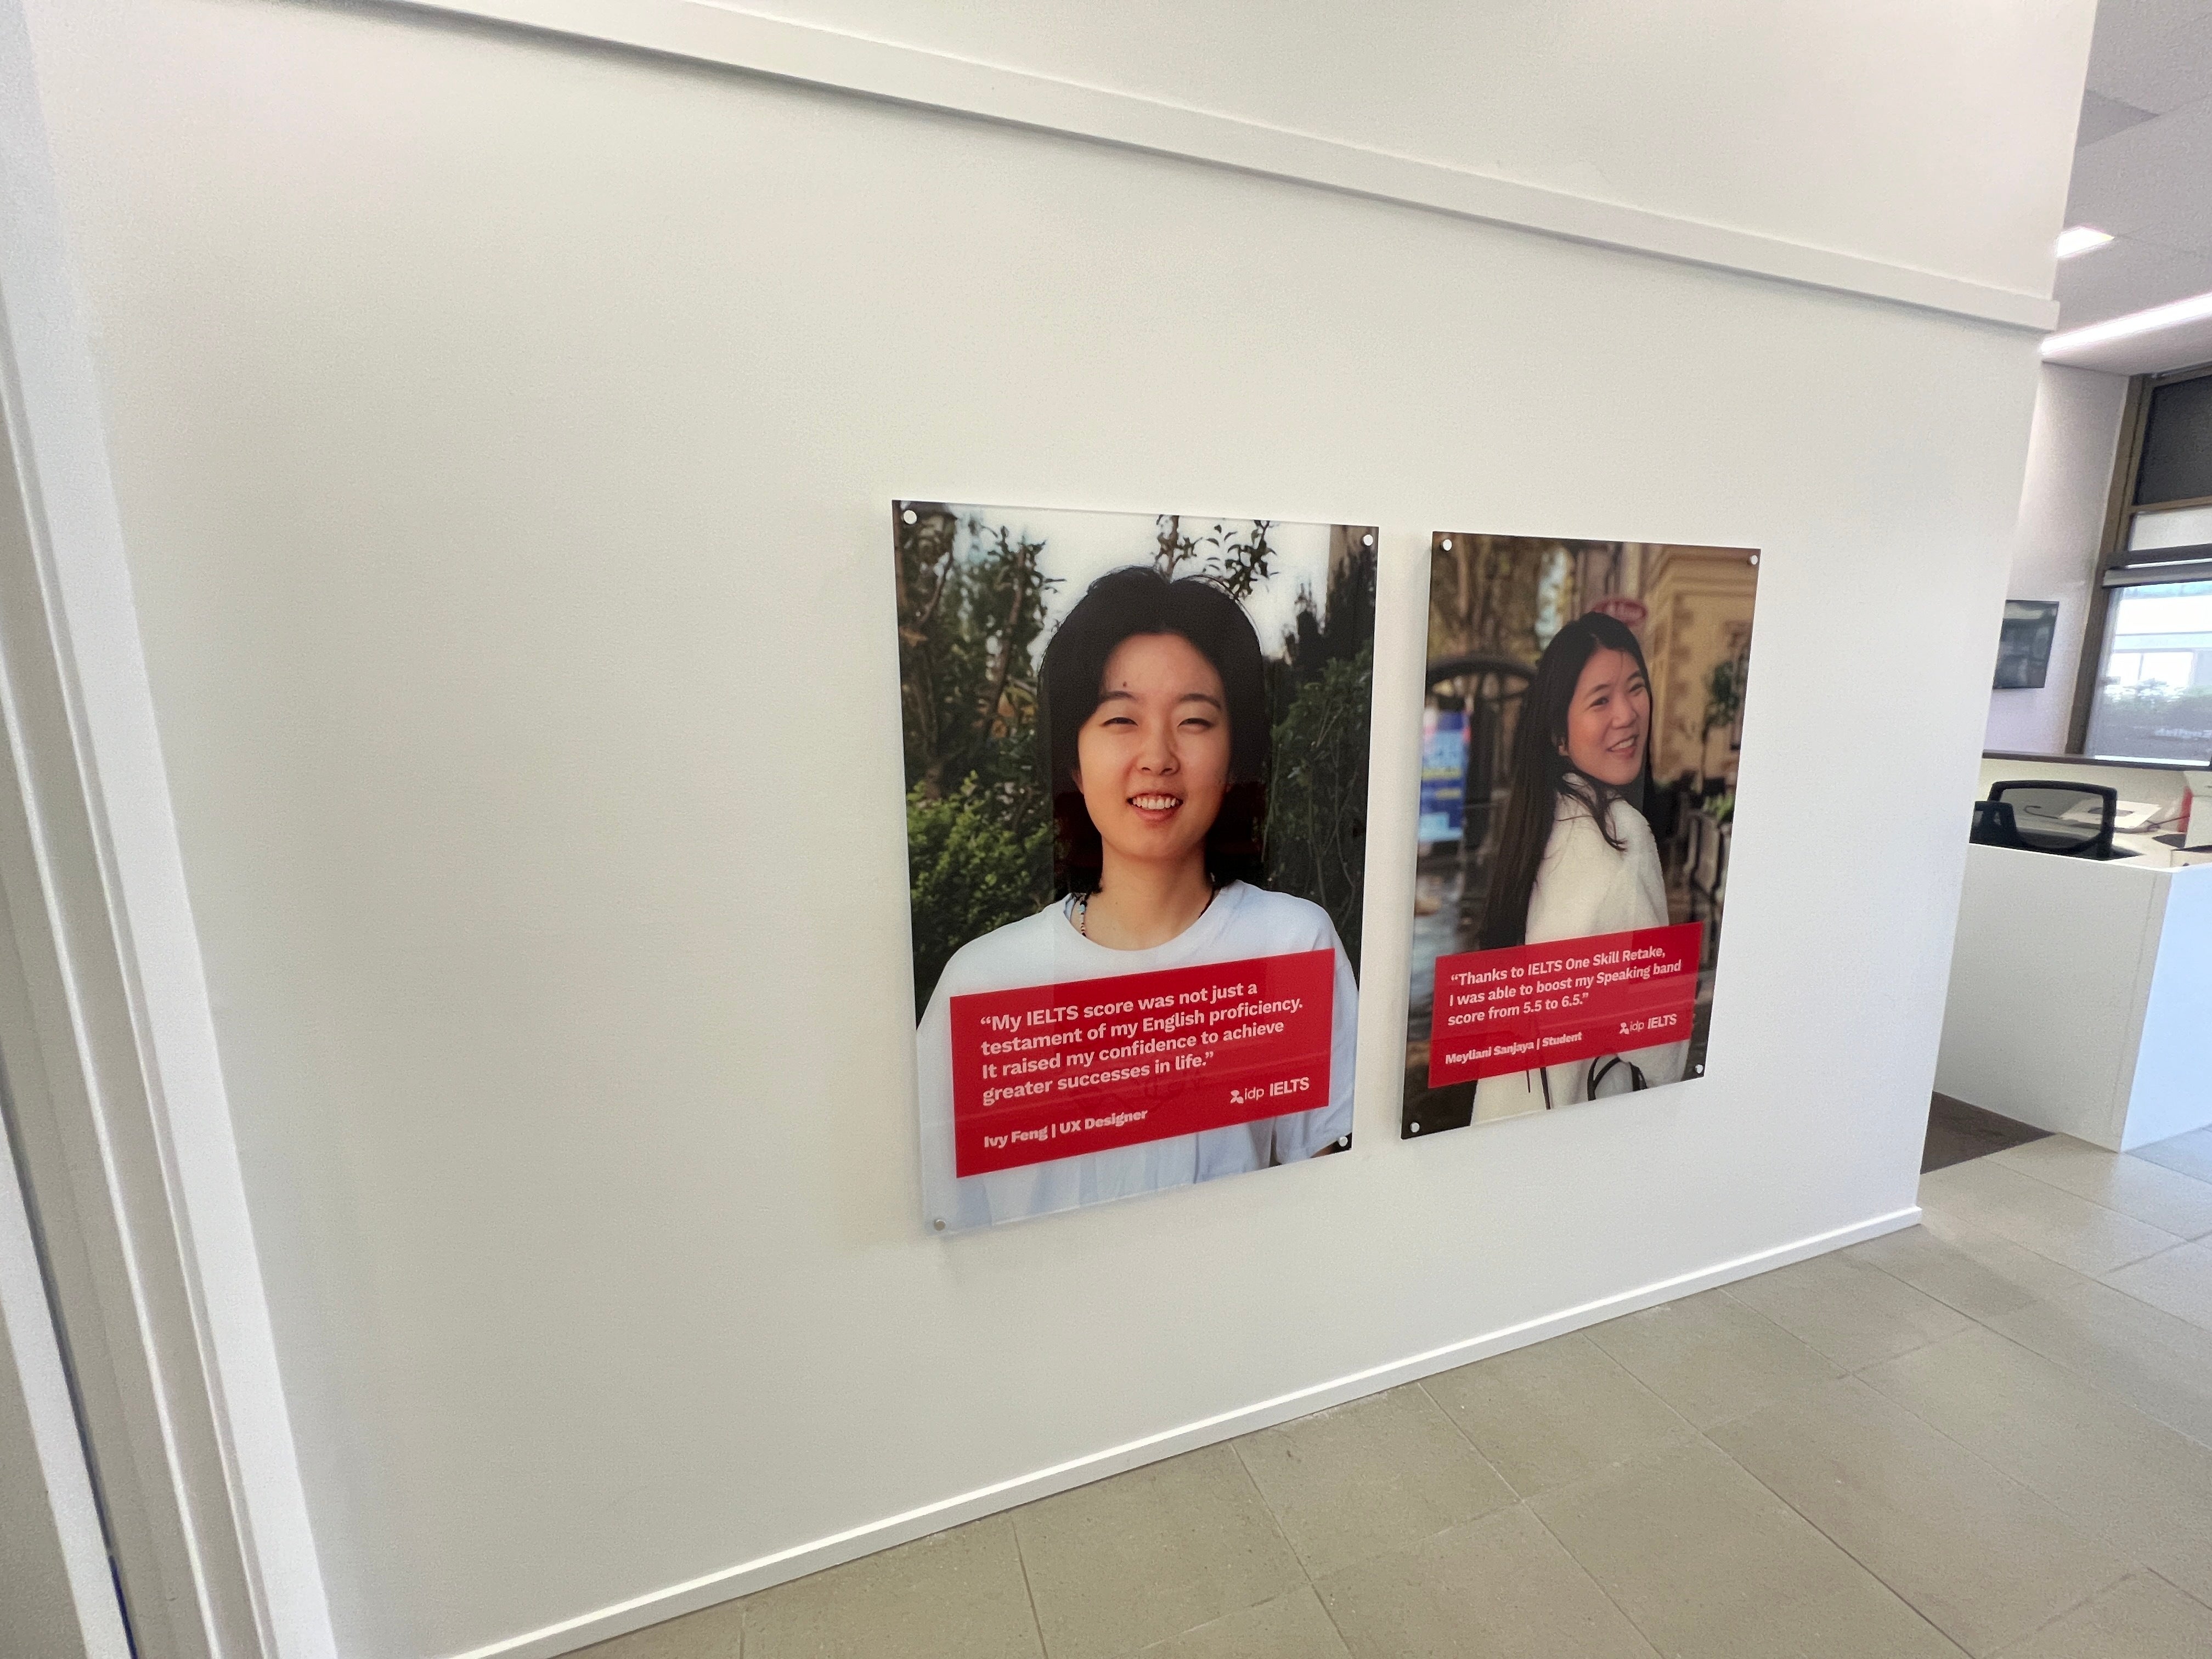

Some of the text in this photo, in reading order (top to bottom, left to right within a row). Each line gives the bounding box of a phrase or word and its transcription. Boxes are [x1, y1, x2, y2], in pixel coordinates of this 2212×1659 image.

[1510, 966, 1525, 979] to
[1527, 960, 1563, 976] IELTS
[1565, 957, 1590, 970] One
[1592, 950, 1620, 966] Skill
[1622, 945, 1666, 962] Retake,
[1449, 958, 1682, 1007] I was able to boost my Speaking band
[1026, 1005, 1079, 1026] IELTS
[1083, 1001, 1134, 1018] score
[1137, 995, 1175, 1011] was
[1179, 988, 1209, 1005] not
[1209, 983, 1244, 1005] just
[1247, 983, 1258, 995] a
[1447, 1011, 1486, 1026] score
[1488, 1006, 1520, 1020] from
[1522, 1000, 1542, 1014] 5.5
[1544, 998, 1559, 1011] to
[1629, 1013, 1678, 1032] idp IELTS
[980, 998, 1303, 1056] testament of my English proficiency.
[982, 1022, 1284, 1080] It raised my confidence to achieve
[1445, 1046, 1492, 1065] Meyliani
[1493, 1041, 1535, 1056] Sanjaya
[1542, 1031, 1583, 1047] Student
[983, 1080, 1053, 1107] greater
[1057, 1065, 1150, 1091] successes
[1154, 1059, 1171, 1075] in
[1244, 1076, 1310, 1101] idp IELTS
[984, 1135, 1009, 1149] Ivy
[1011, 1125, 1048, 1143] Feng
[1059, 1119, 1082, 1135] UX
[1084, 1110, 1148, 1130] Designer
